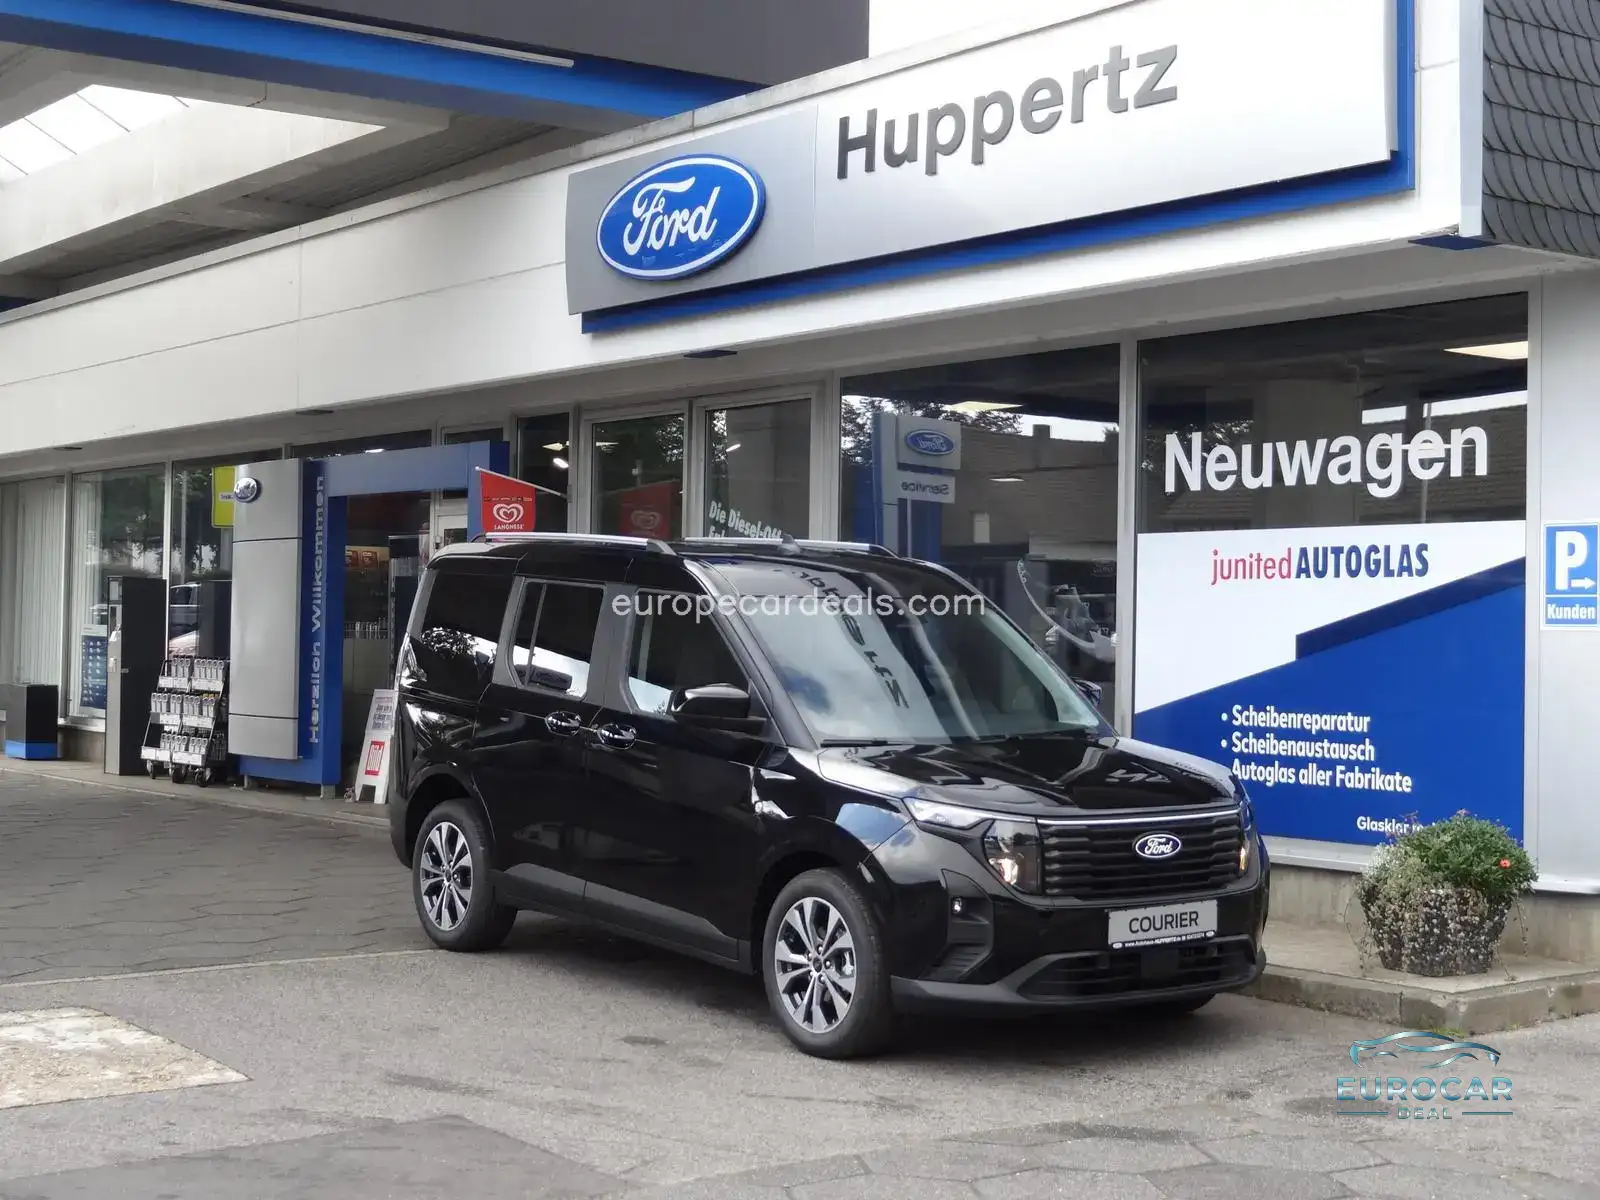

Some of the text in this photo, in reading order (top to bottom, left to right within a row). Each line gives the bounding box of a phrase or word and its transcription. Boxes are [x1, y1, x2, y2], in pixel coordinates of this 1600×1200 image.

[837, 45, 1178, 180] Huppertz
[623, 176, 721, 256] Ford
[1164, 425, 1489, 498] Neuwagen
[709, 500, 727, 523] Die
[311, 475, 325, 634] Willkommen
[1555, 530, 1588, 591] P
[1547, 603, 1596, 619] Kunden
[1231, 704, 1371, 735] Scheibenreparatur
[1231, 731, 1375, 762] Scheibenaustausch
[1231, 758, 1413, 793] Autoglas aller Fabrikate
[1356, 815, 1410, 834] Glasklar
[1144, 837, 1173, 855] Ford
[1128, 911, 1199, 934] COURIER
